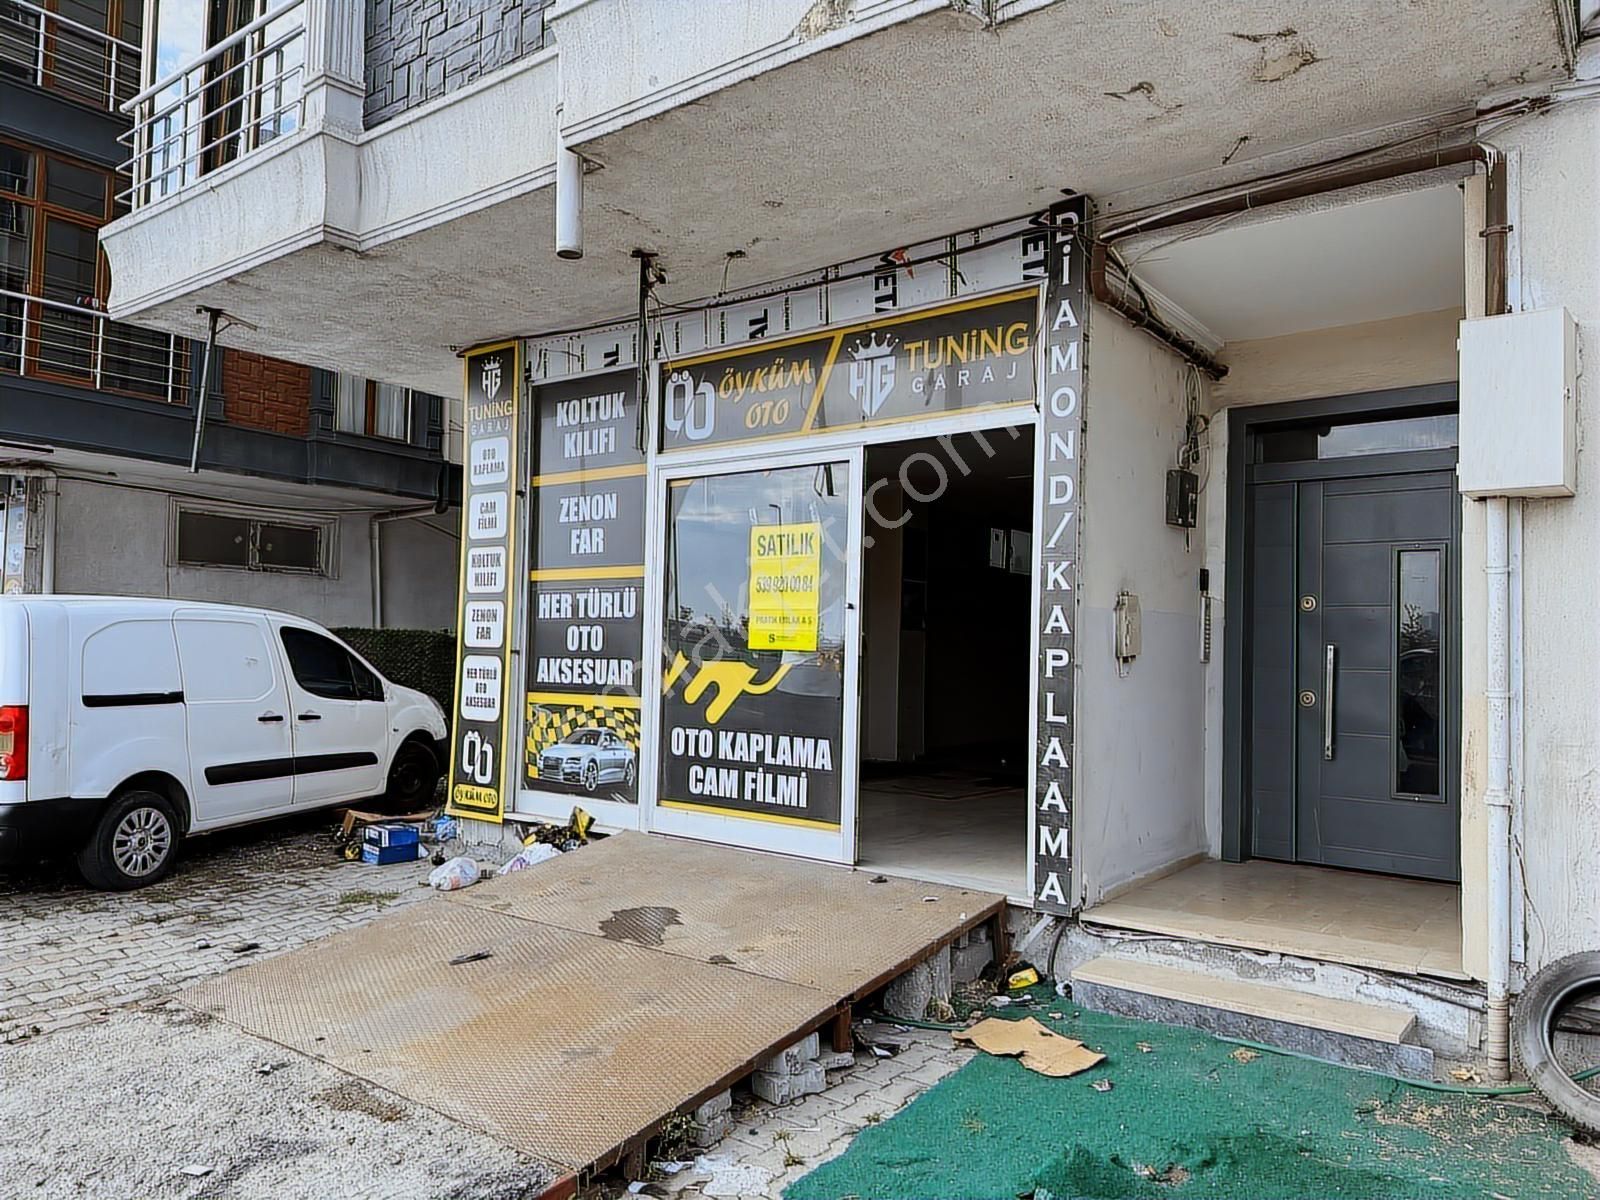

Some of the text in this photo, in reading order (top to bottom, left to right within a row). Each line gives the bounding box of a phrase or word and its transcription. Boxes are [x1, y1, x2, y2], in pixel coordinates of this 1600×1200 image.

[912, 361, 1018, 394] GARAJ
[556, 391, 626, 428] KOLTUK
[745, 398, 789, 429] OTO
[471, 418, 511, 437] GARAJ
[482, 447, 497, 462] OTO
[563, 426, 616, 460] KILIFI
[473, 460, 506, 477] KAPLAMA
[479, 500, 497, 516] CAM
[559, 492, 618, 523] ZENON
[570, 527, 605, 555] FAR
[757, 532, 815, 557] SATILIK
[471, 551, 502, 569] KOLTUK
[474, 571, 498, 588] KILIFI
[538, 586, 637, 620] HER TÜRLÜ
[471, 608, 498, 624] ZENON
[476, 626, 492, 642] FAR
[566, 624, 604, 653] OTO
[466, 665, 498, 681] HER TÜRLÜ
[536, 656, 635, 687] AKSESUAR
[475, 682, 488, 695] OTO
[465, 696, 497, 710] AKSESUAR
[670, 726, 833, 772] OTO KAPLAMA
[688, 764, 808, 809] CAM FİLMİ
